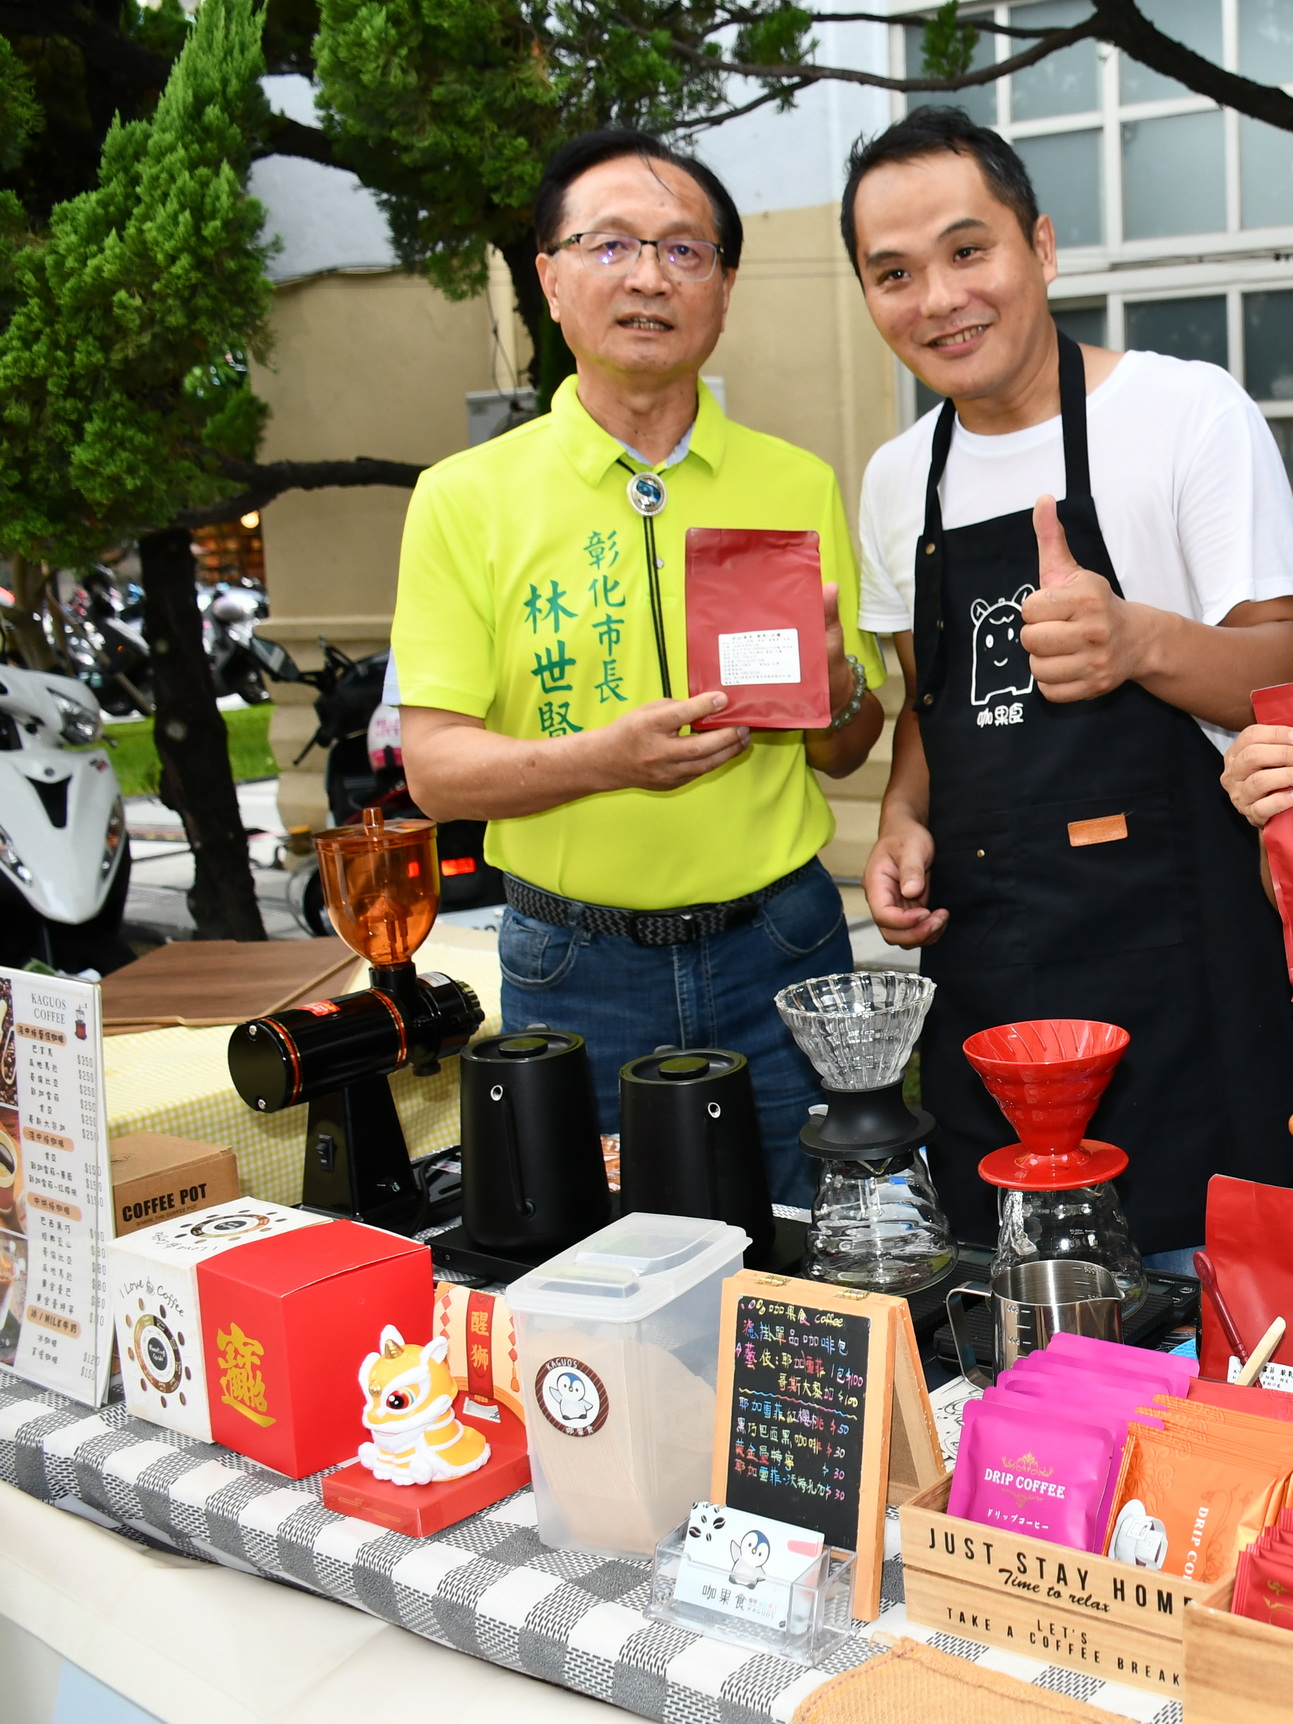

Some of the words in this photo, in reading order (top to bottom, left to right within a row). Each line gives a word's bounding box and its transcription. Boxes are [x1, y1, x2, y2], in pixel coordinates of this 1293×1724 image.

[583, 530, 629, 704] 彰化市長
[31, 993, 67, 1010] KAGUOS
[34, 1008, 66, 1024] COFFEE
[77, 1054, 93, 1068] $350
[78, 1069, 94, 1083] $250
[79, 1084, 95, 1098] $250
[80, 1099, 96, 1113] $250
[122, 1192, 175, 1222] COFFEE
[180, 1183, 207, 1205] POT
[90, 1228, 104, 1242] $0
[125, 1279, 144, 1295] Love
[156, 1285, 185, 1317] Coffee
[545, 1358, 580, 1371] KAGUOS
[826, 1442, 846, 1459] $30
[822, 1462, 845, 1480] $30
[984, 1467, 1014, 1486] DRIP
[1015, 1475, 1066, 1499] COFFEE
[987, 1508, 1049, 1530] ドリップコーヒー
[1191, 1506, 1210, 1547] DRIP
[928, 1528, 994, 1566] JUST
[1015, 1552, 1090, 1592] STAY
[702, 1584, 747, 1612] 咖果食
[998, 1567, 1041, 1595] Time
[1047, 1585, 1064, 1600] to
[1068, 1588, 1111, 1613] relax
[1036, 1618, 1088, 1645] LET'S
[946, 1607, 991, 1632] TAKE
[1006, 1625, 1014, 1639] A
[1029, 1631, 1101, 1664] COFFEE
[1117, 1657, 1181, 1687] BREAK
